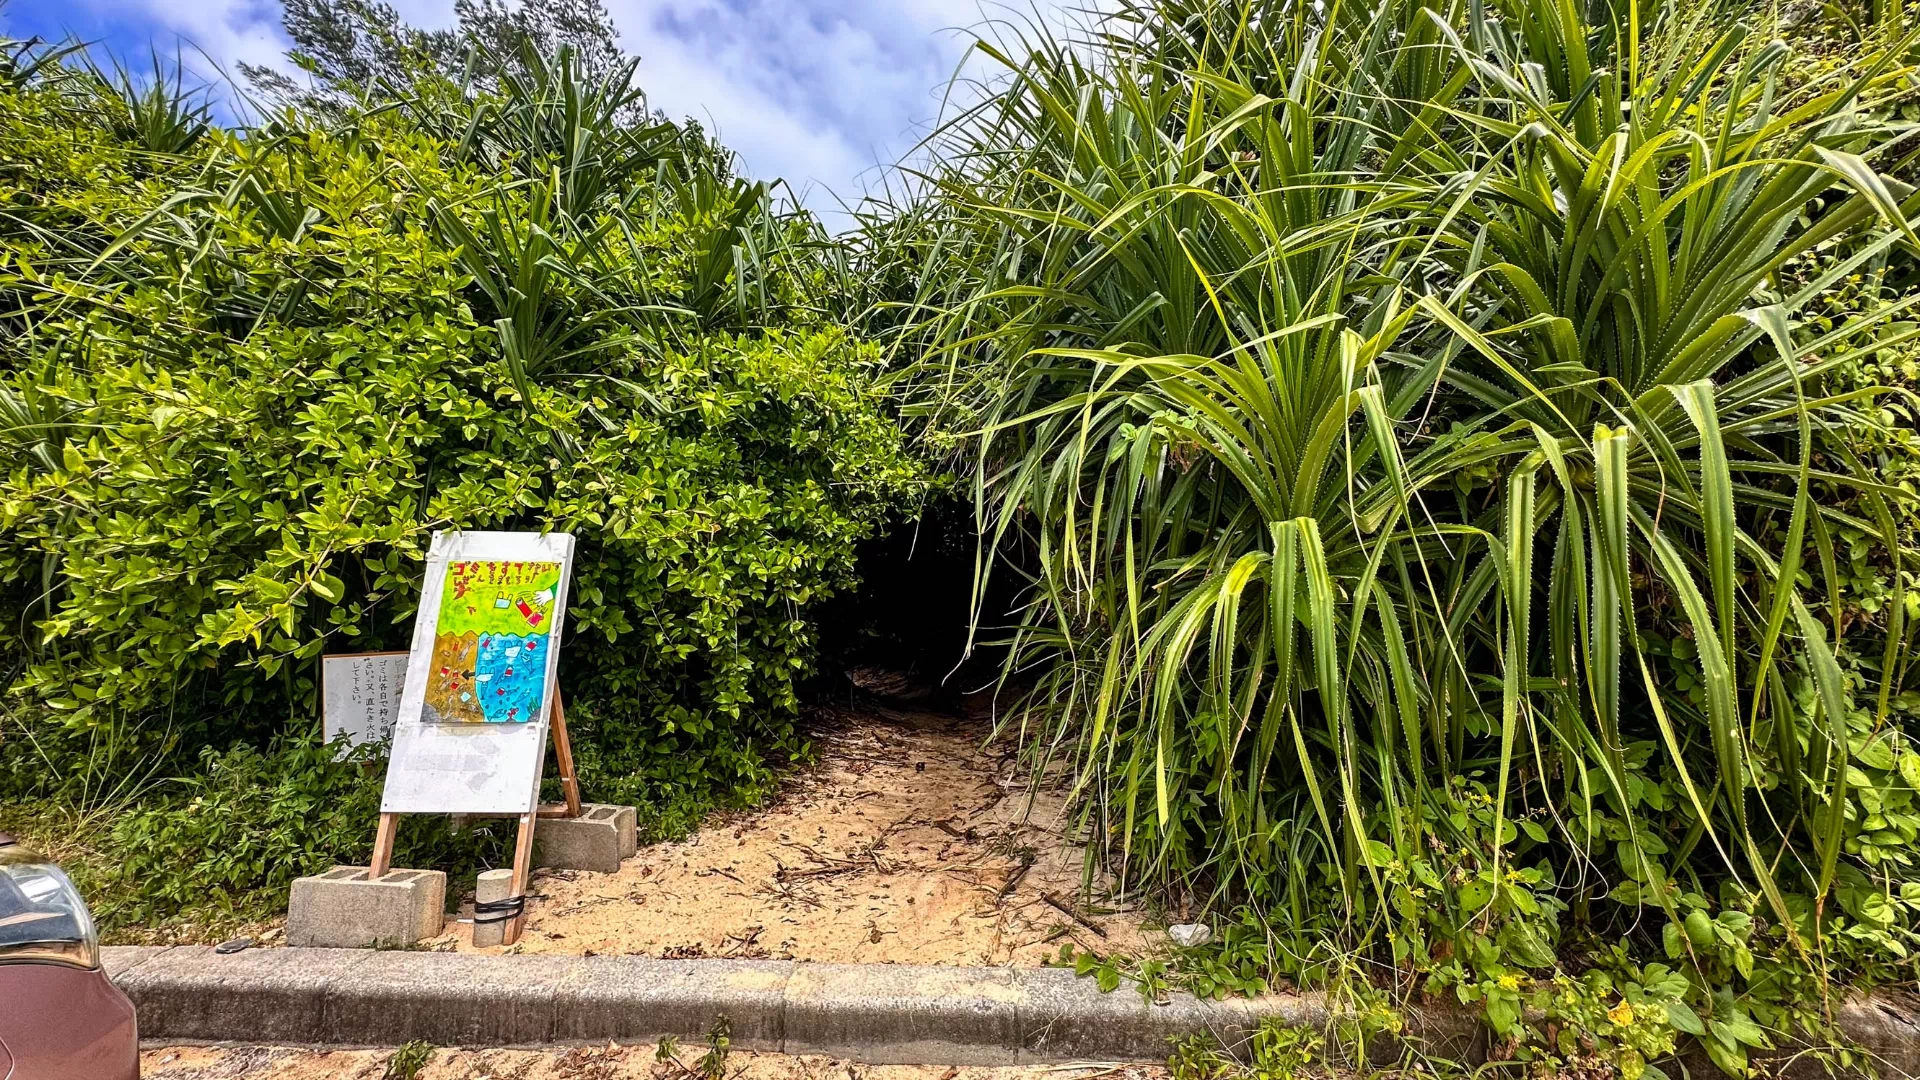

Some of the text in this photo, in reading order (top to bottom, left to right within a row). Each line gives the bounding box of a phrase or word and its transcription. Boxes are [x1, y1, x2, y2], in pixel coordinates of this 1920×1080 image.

[351, 661, 362, 704] して下さい。
